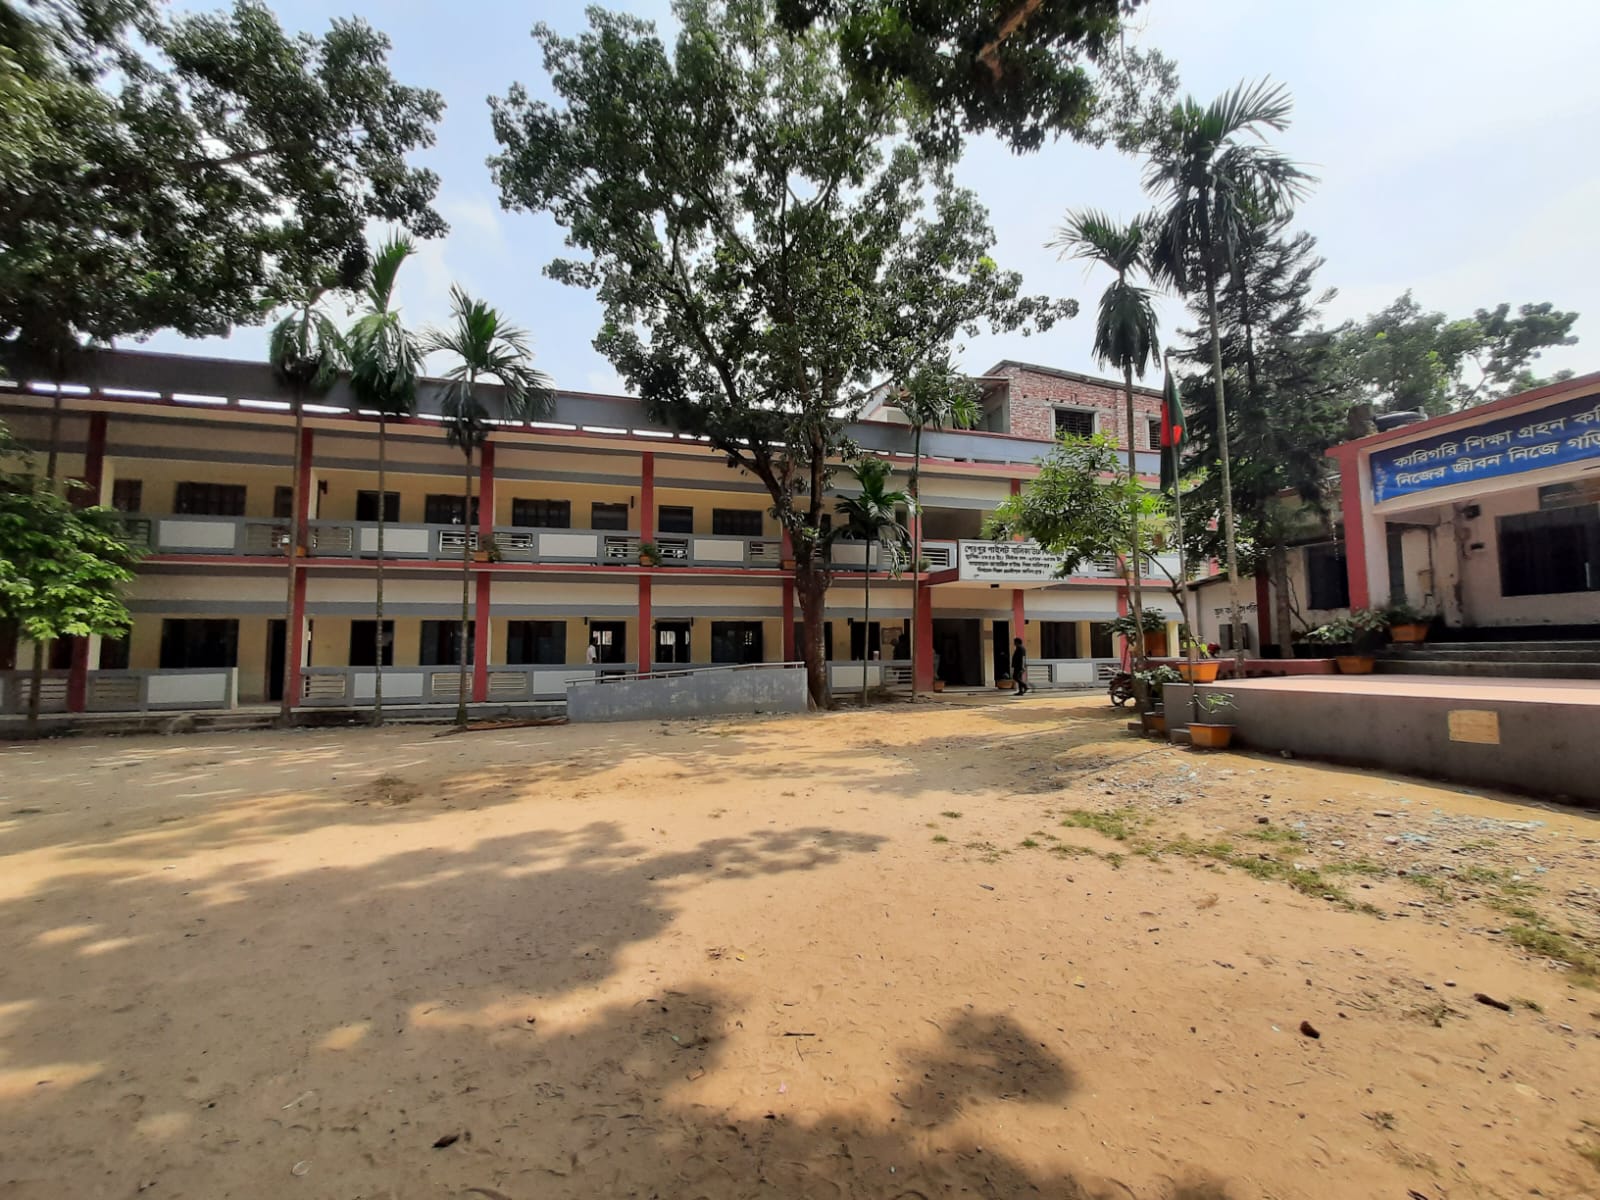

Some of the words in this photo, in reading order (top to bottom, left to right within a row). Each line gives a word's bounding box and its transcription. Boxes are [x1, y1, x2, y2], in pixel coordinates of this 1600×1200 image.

[1393, 442, 1459, 468] কারিগরি
[1464, 430, 1512, 452] শিক্ষা
[1517, 417, 1567, 439] গ্রহন
[1395, 466, 1447, 488] নিজের
[1451, 454, 1504, 473] জীবন
[1508, 441, 1561, 463] নিজে
